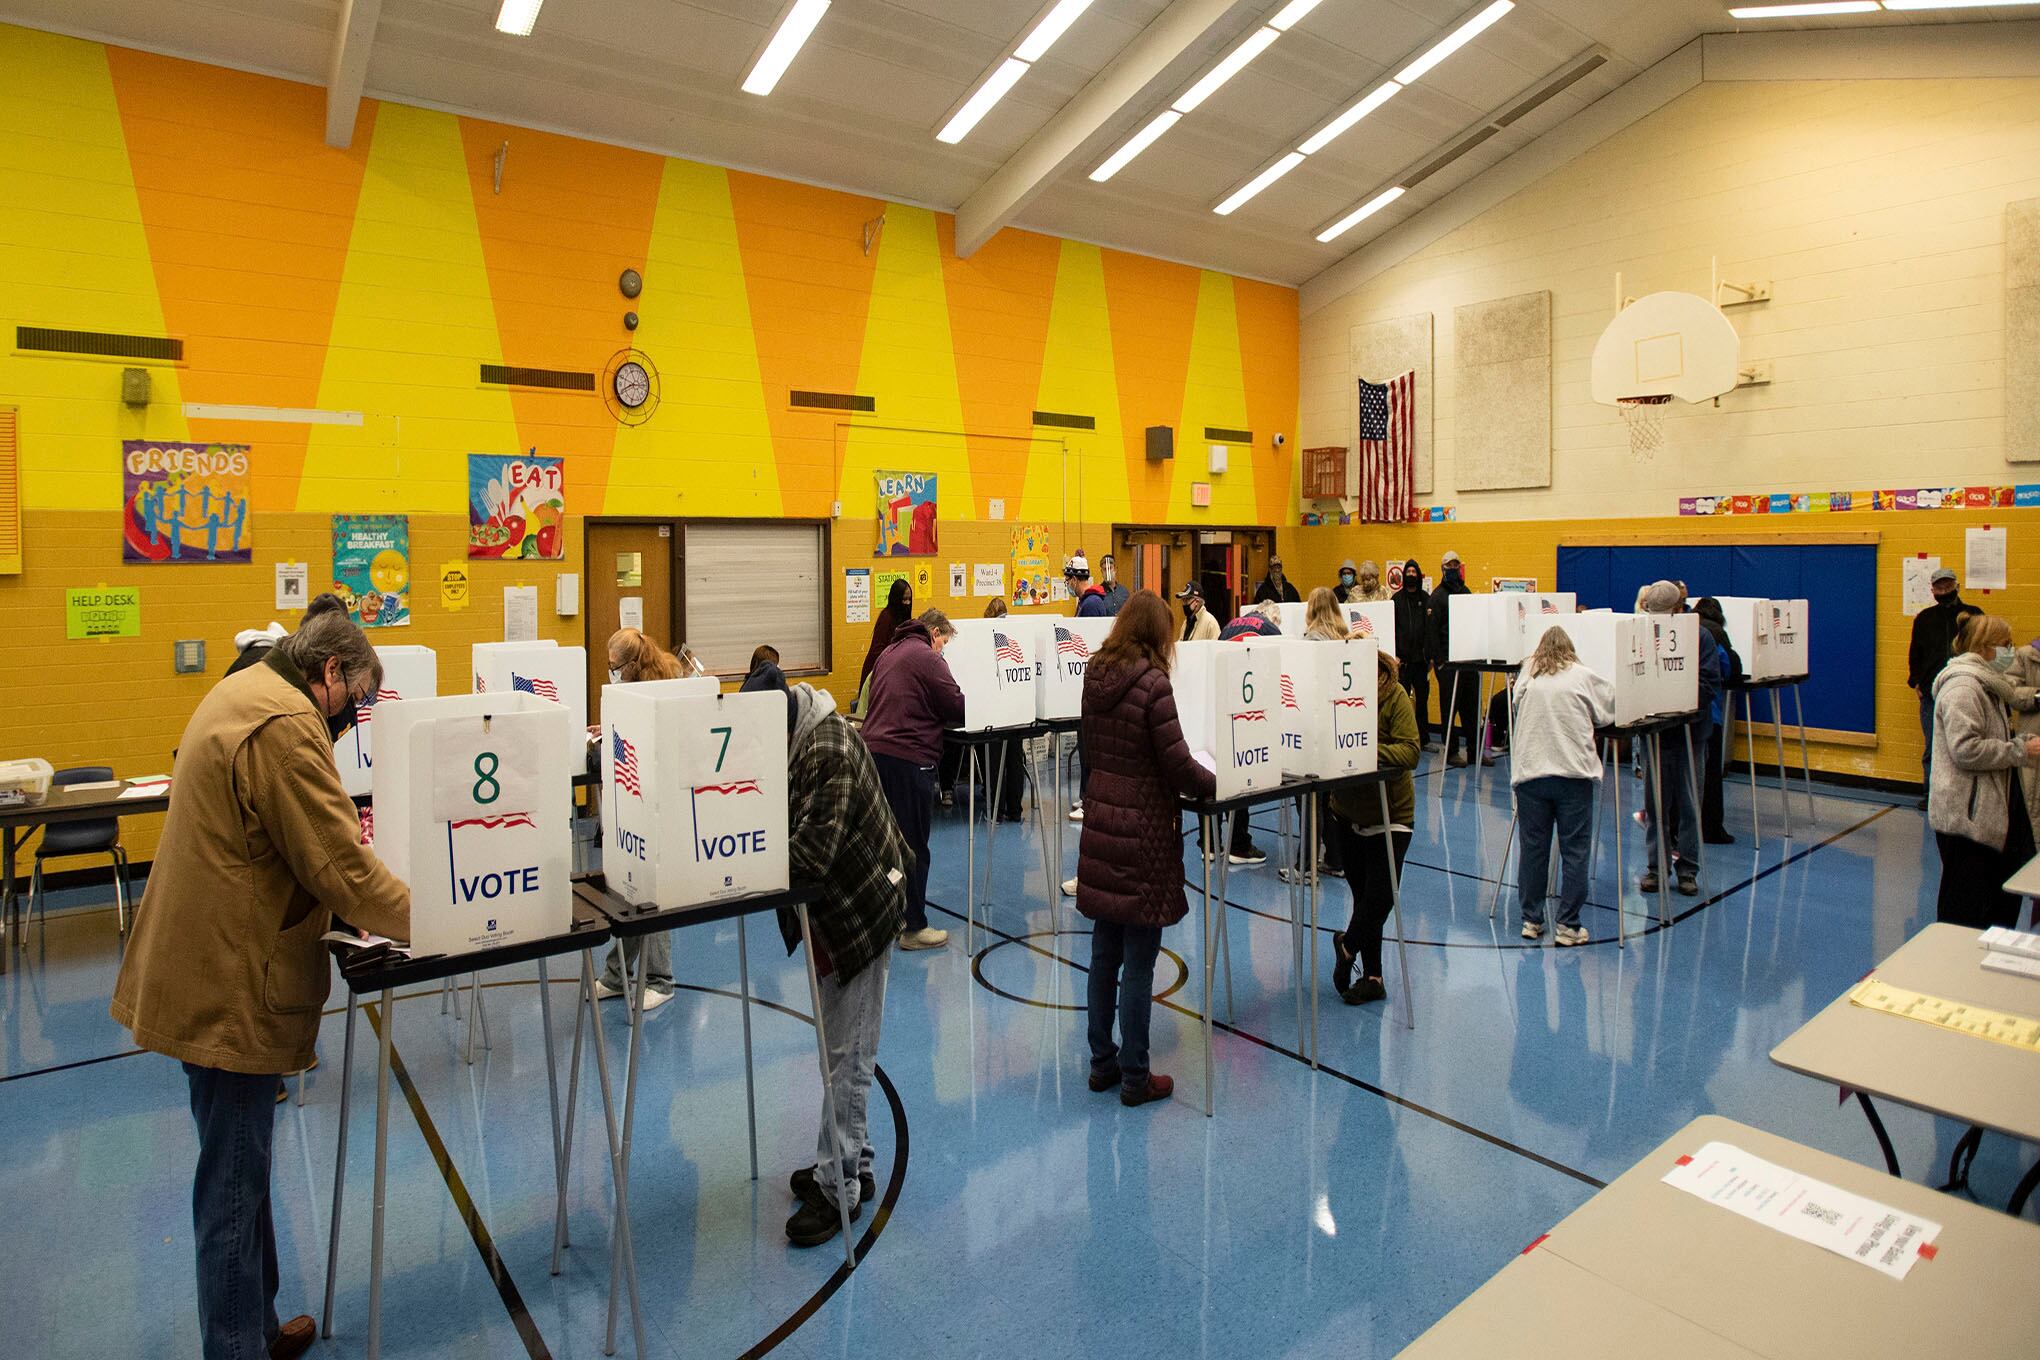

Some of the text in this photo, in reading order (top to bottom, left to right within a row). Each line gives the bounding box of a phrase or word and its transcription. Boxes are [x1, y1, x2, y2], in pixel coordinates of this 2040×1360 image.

[131, 449, 246, 474] FRIENDS
[512, 464, 558, 489] EAT
[879, 474, 924, 496] LEARN
[347, 541, 395, 549] BREAKFAST
[351, 532, 388, 541] HEALTHY
[447, 573, 462, 581] STOP
[976, 579, 995, 587] Precinct
[72, 594, 134, 607] HELP DESK
[1669, 629, 1677, 652] 3
[1067, 661, 1088, 675] VOT
[1663, 657, 1684, 671] VOTE
[1005, 667, 1031, 683] VOTE
[1341, 661, 1352, 692] 5
[1242, 671, 1254, 704] 6
[710, 726, 732, 773] 7
[1281, 733, 1302, 750] TE
[1338, 731, 1368, 749] VOTE
[1236, 746, 1269, 767] VOTE
[472, 752, 500, 805] 8
[618, 827, 646, 862] VOTE
[701, 829, 767, 861] VOTE
[459, 866, 539, 903] VOTE
